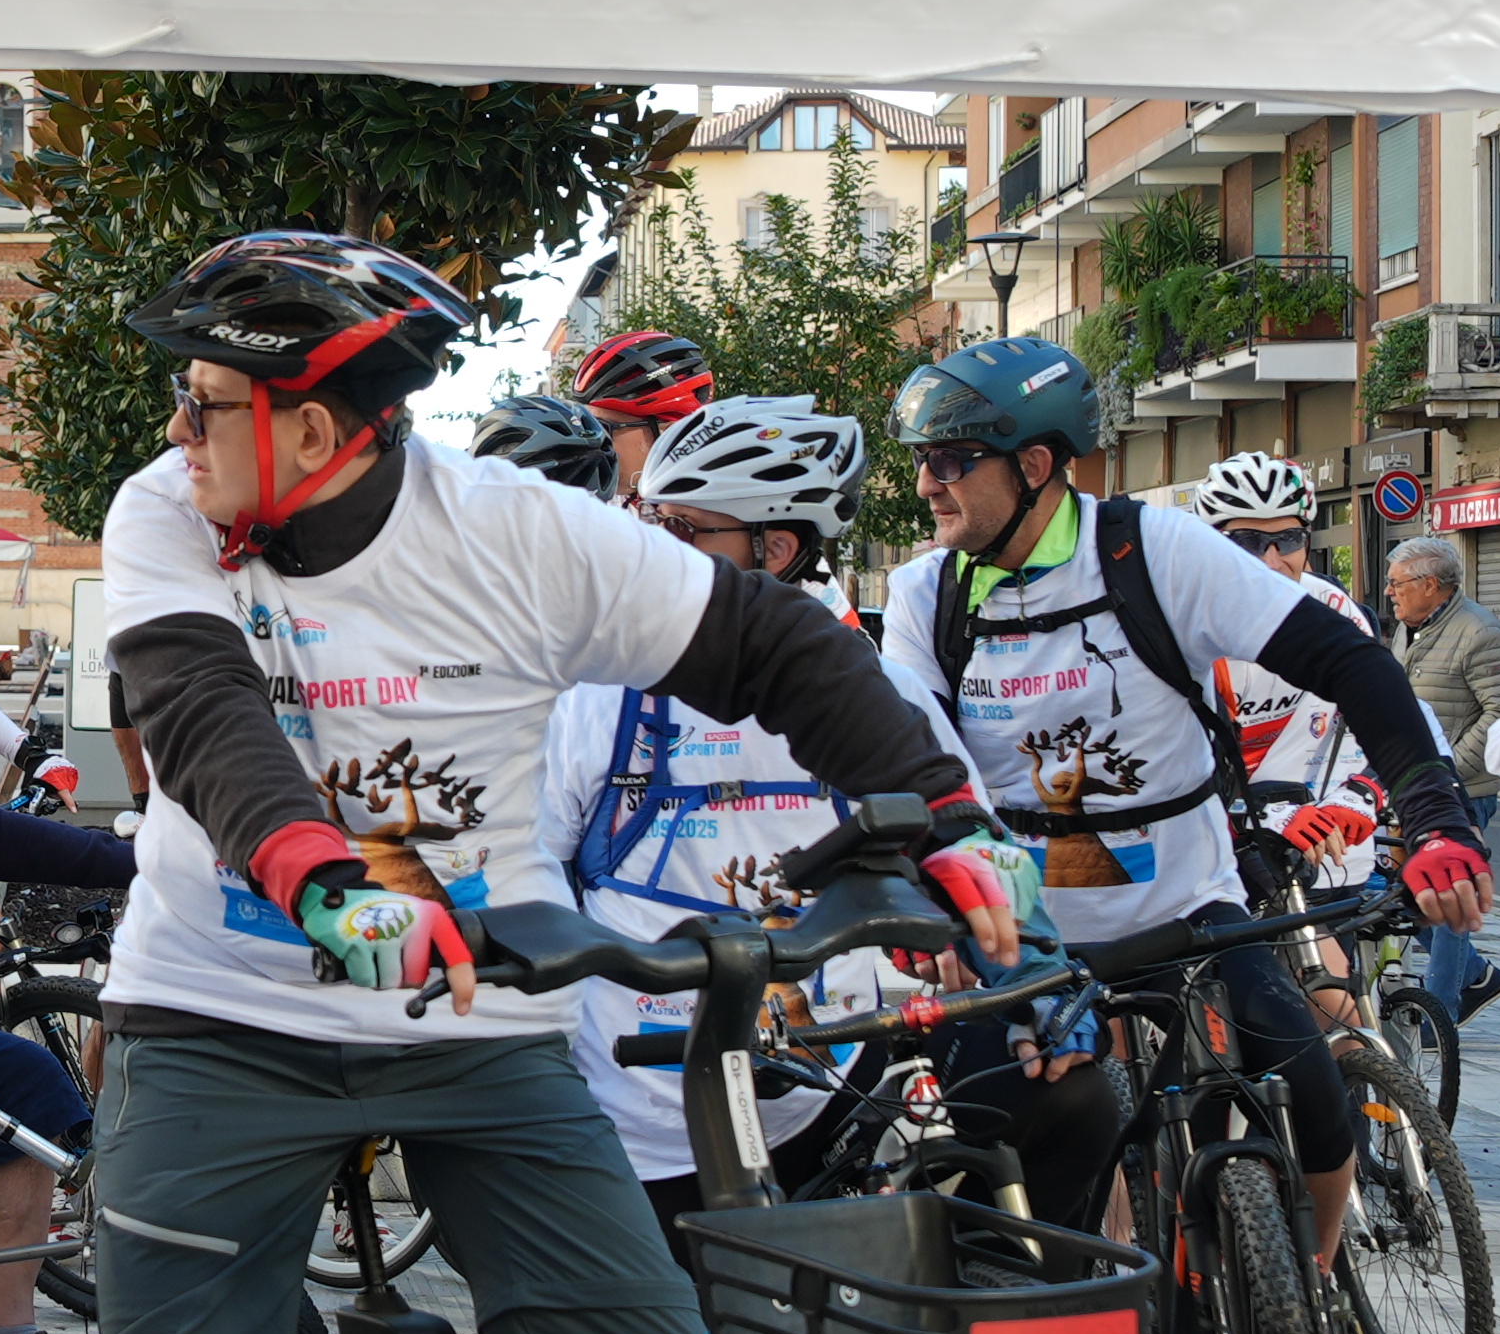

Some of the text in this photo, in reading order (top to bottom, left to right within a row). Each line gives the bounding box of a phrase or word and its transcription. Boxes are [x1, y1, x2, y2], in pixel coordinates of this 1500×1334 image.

[208, 325, 300, 349] RUDY
[667, 415, 725, 464] TRENTINO
[296, 677, 367, 710] SPORT
[376, 675, 420, 706] DAY
[433, 663, 482, 679] EDIZIONE
[962, 667, 1089, 699] ECIAL SPORT DAY
[683, 742, 742, 757] SPORT DAY
